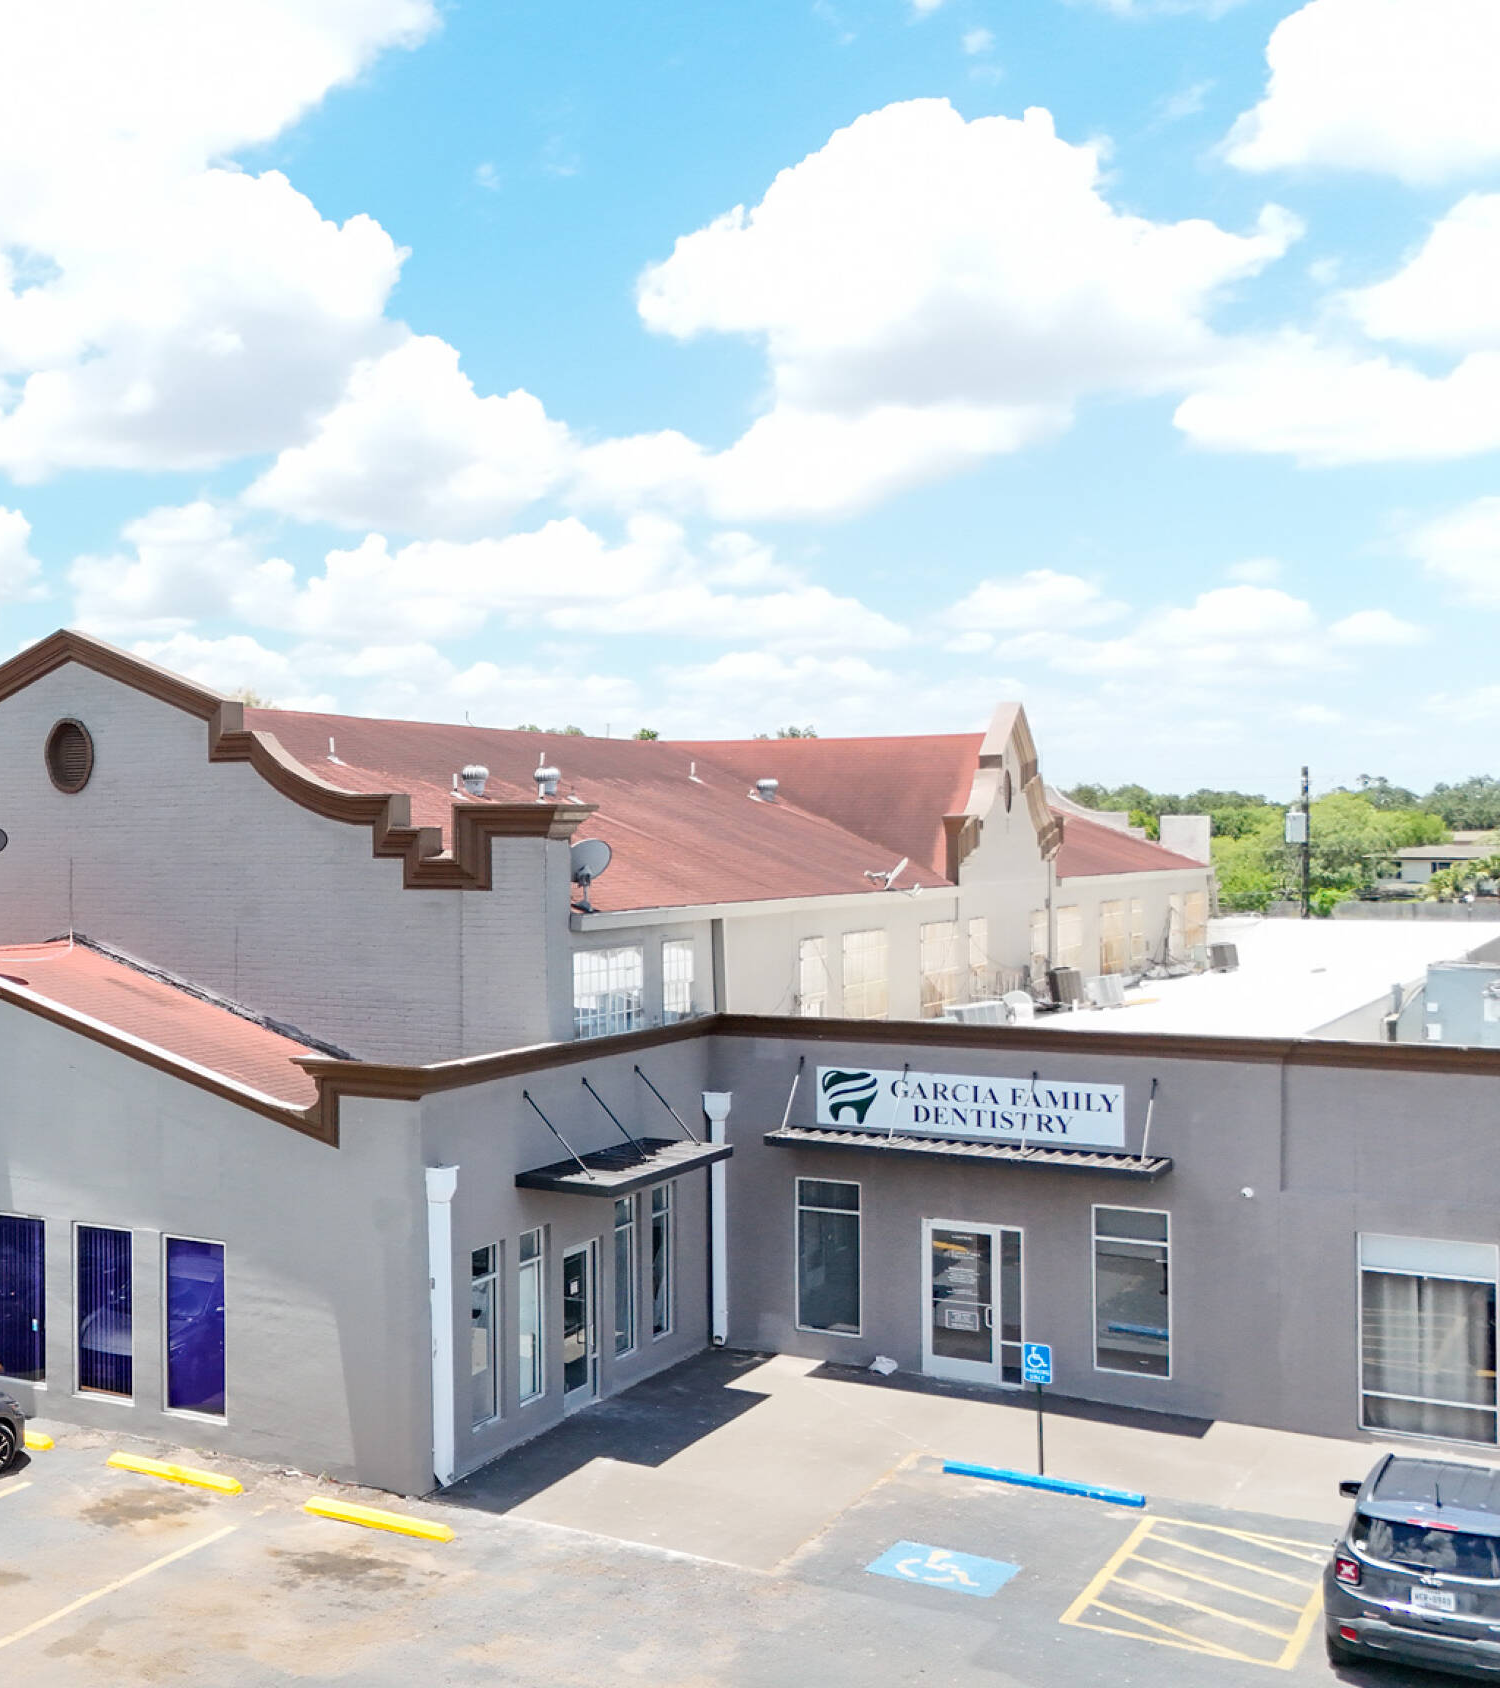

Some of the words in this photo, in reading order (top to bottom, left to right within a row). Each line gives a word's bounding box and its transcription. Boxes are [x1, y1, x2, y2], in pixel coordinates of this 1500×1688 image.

[890, 1079, 999, 1105] GARCIA
[1011, 1088, 1119, 1112] FAMILY
[913, 1104, 1074, 1134] DENTISTRY
